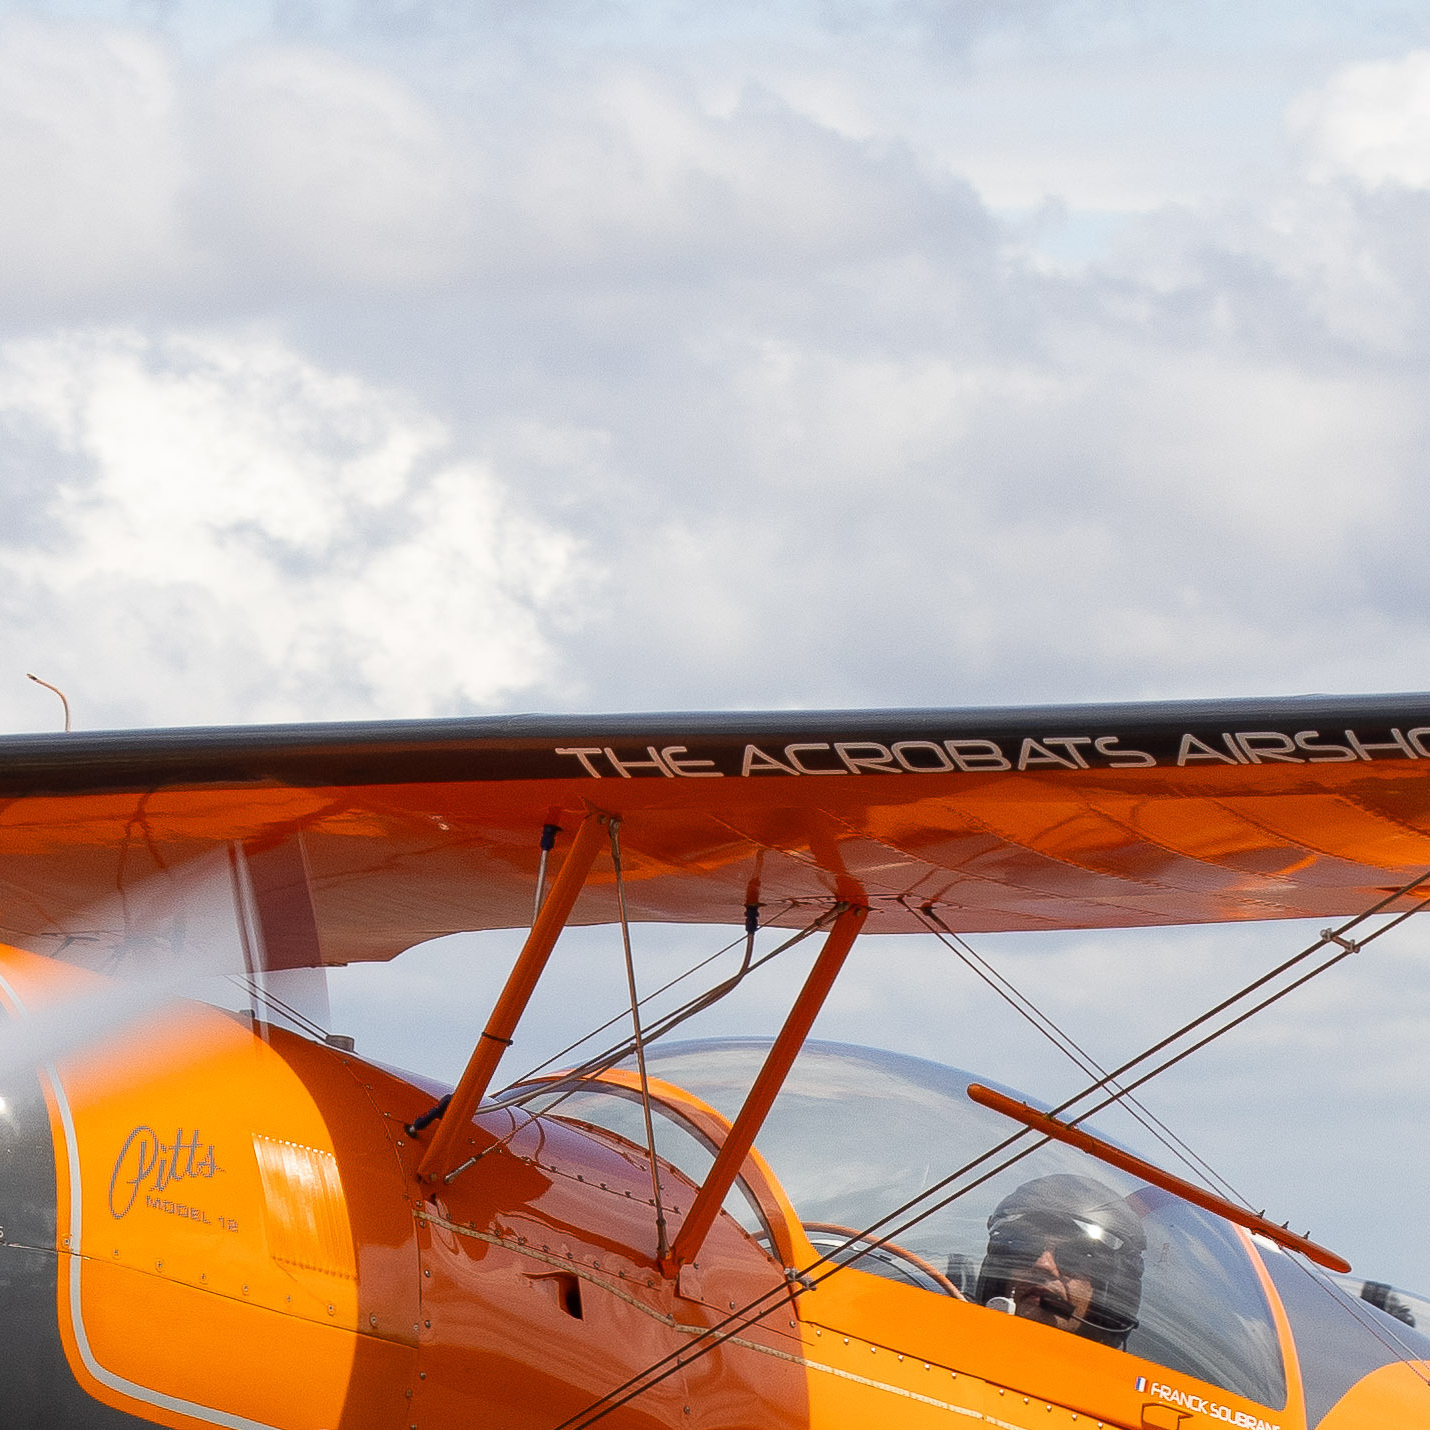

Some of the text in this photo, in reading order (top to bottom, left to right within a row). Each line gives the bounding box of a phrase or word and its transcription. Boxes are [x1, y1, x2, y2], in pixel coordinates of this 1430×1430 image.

[555, 745, 724, 779] THE
[741, 736, 1157, 778] ACROBATS
[108, 1125, 226, 1220] Pitts
[146, 1194, 239, 1233] MODEL 12
[1150, 1382, 1210, 1415] FRANCK
